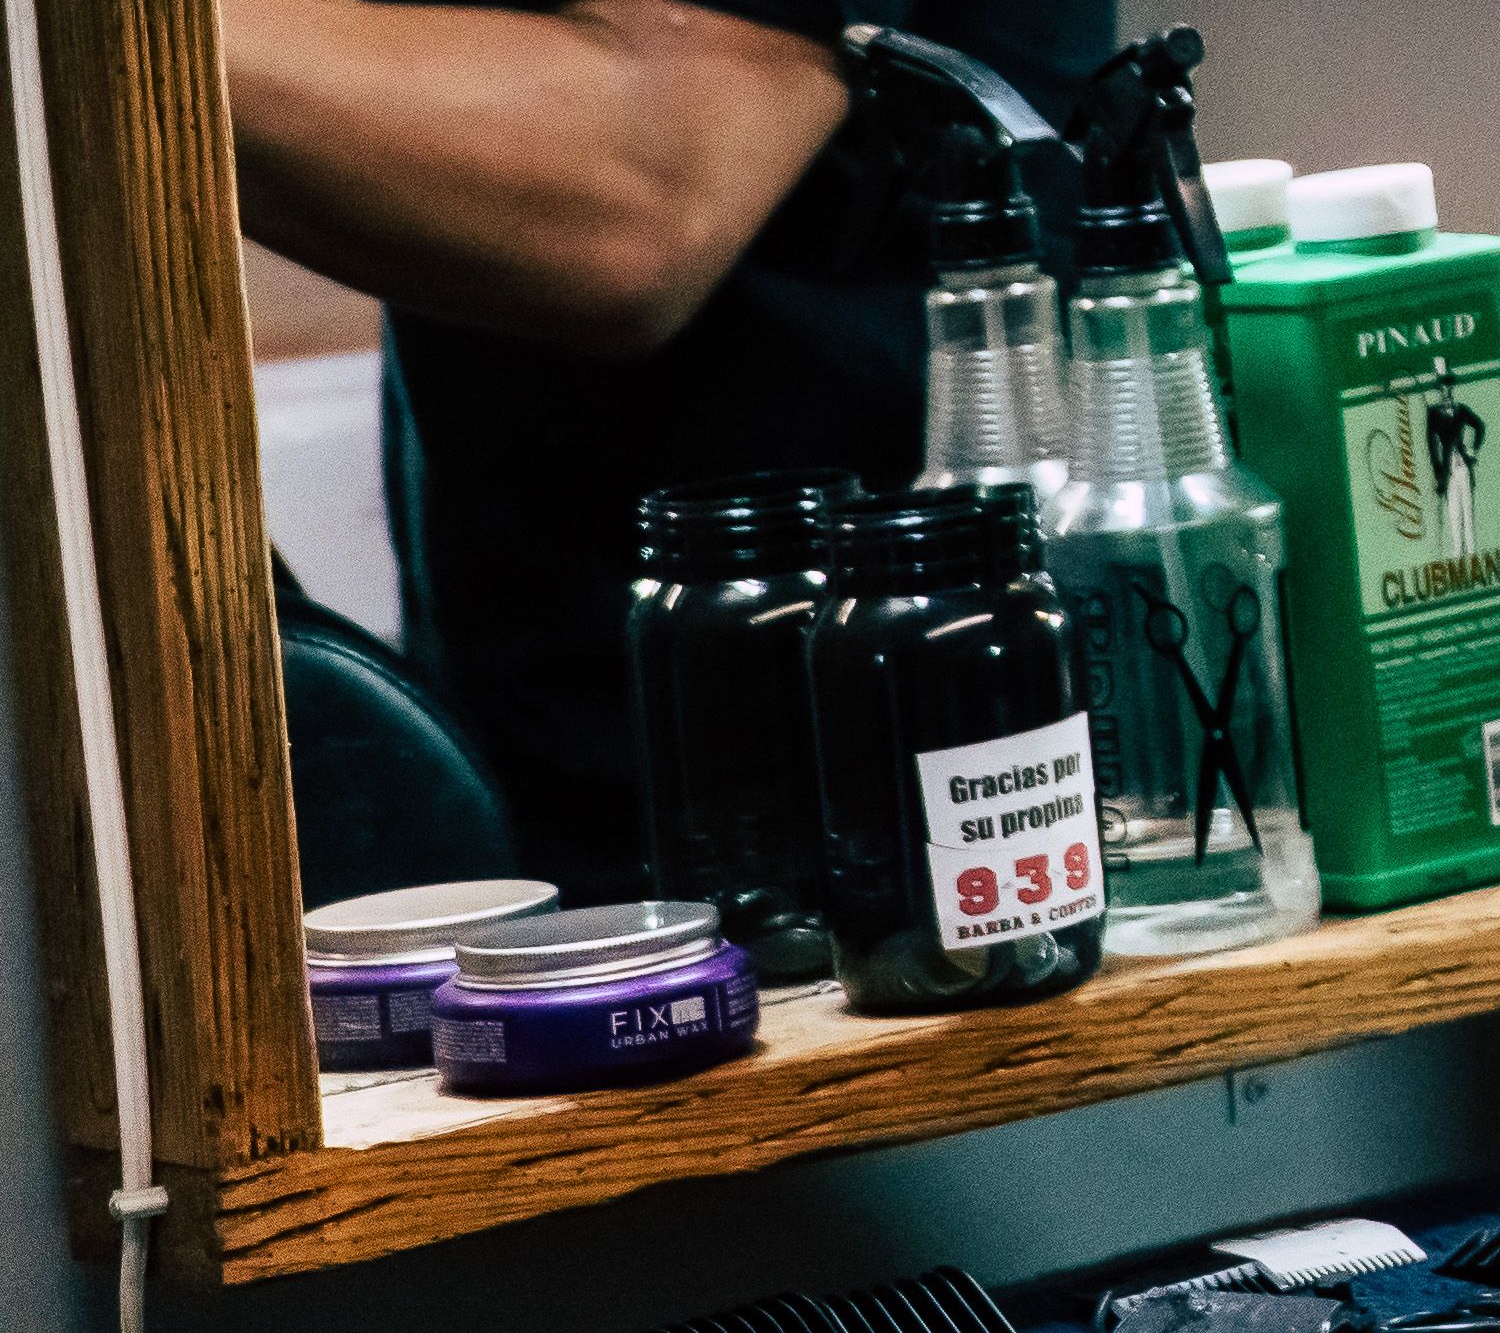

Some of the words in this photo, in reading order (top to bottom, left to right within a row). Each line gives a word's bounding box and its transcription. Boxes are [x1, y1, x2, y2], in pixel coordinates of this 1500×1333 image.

[1358, 313, 1477, 358] PINAUD
[950, 762, 1049, 805] Gracias
[1052, 752, 1082, 784] por
[960, 815, 996, 843] su
[1001, 792, 1084, 838] propina
[956, 915, 1025, 940] BARBA
[611, 1006, 668, 1035] FIX
[611, 1031, 669, 1049] URBAN
